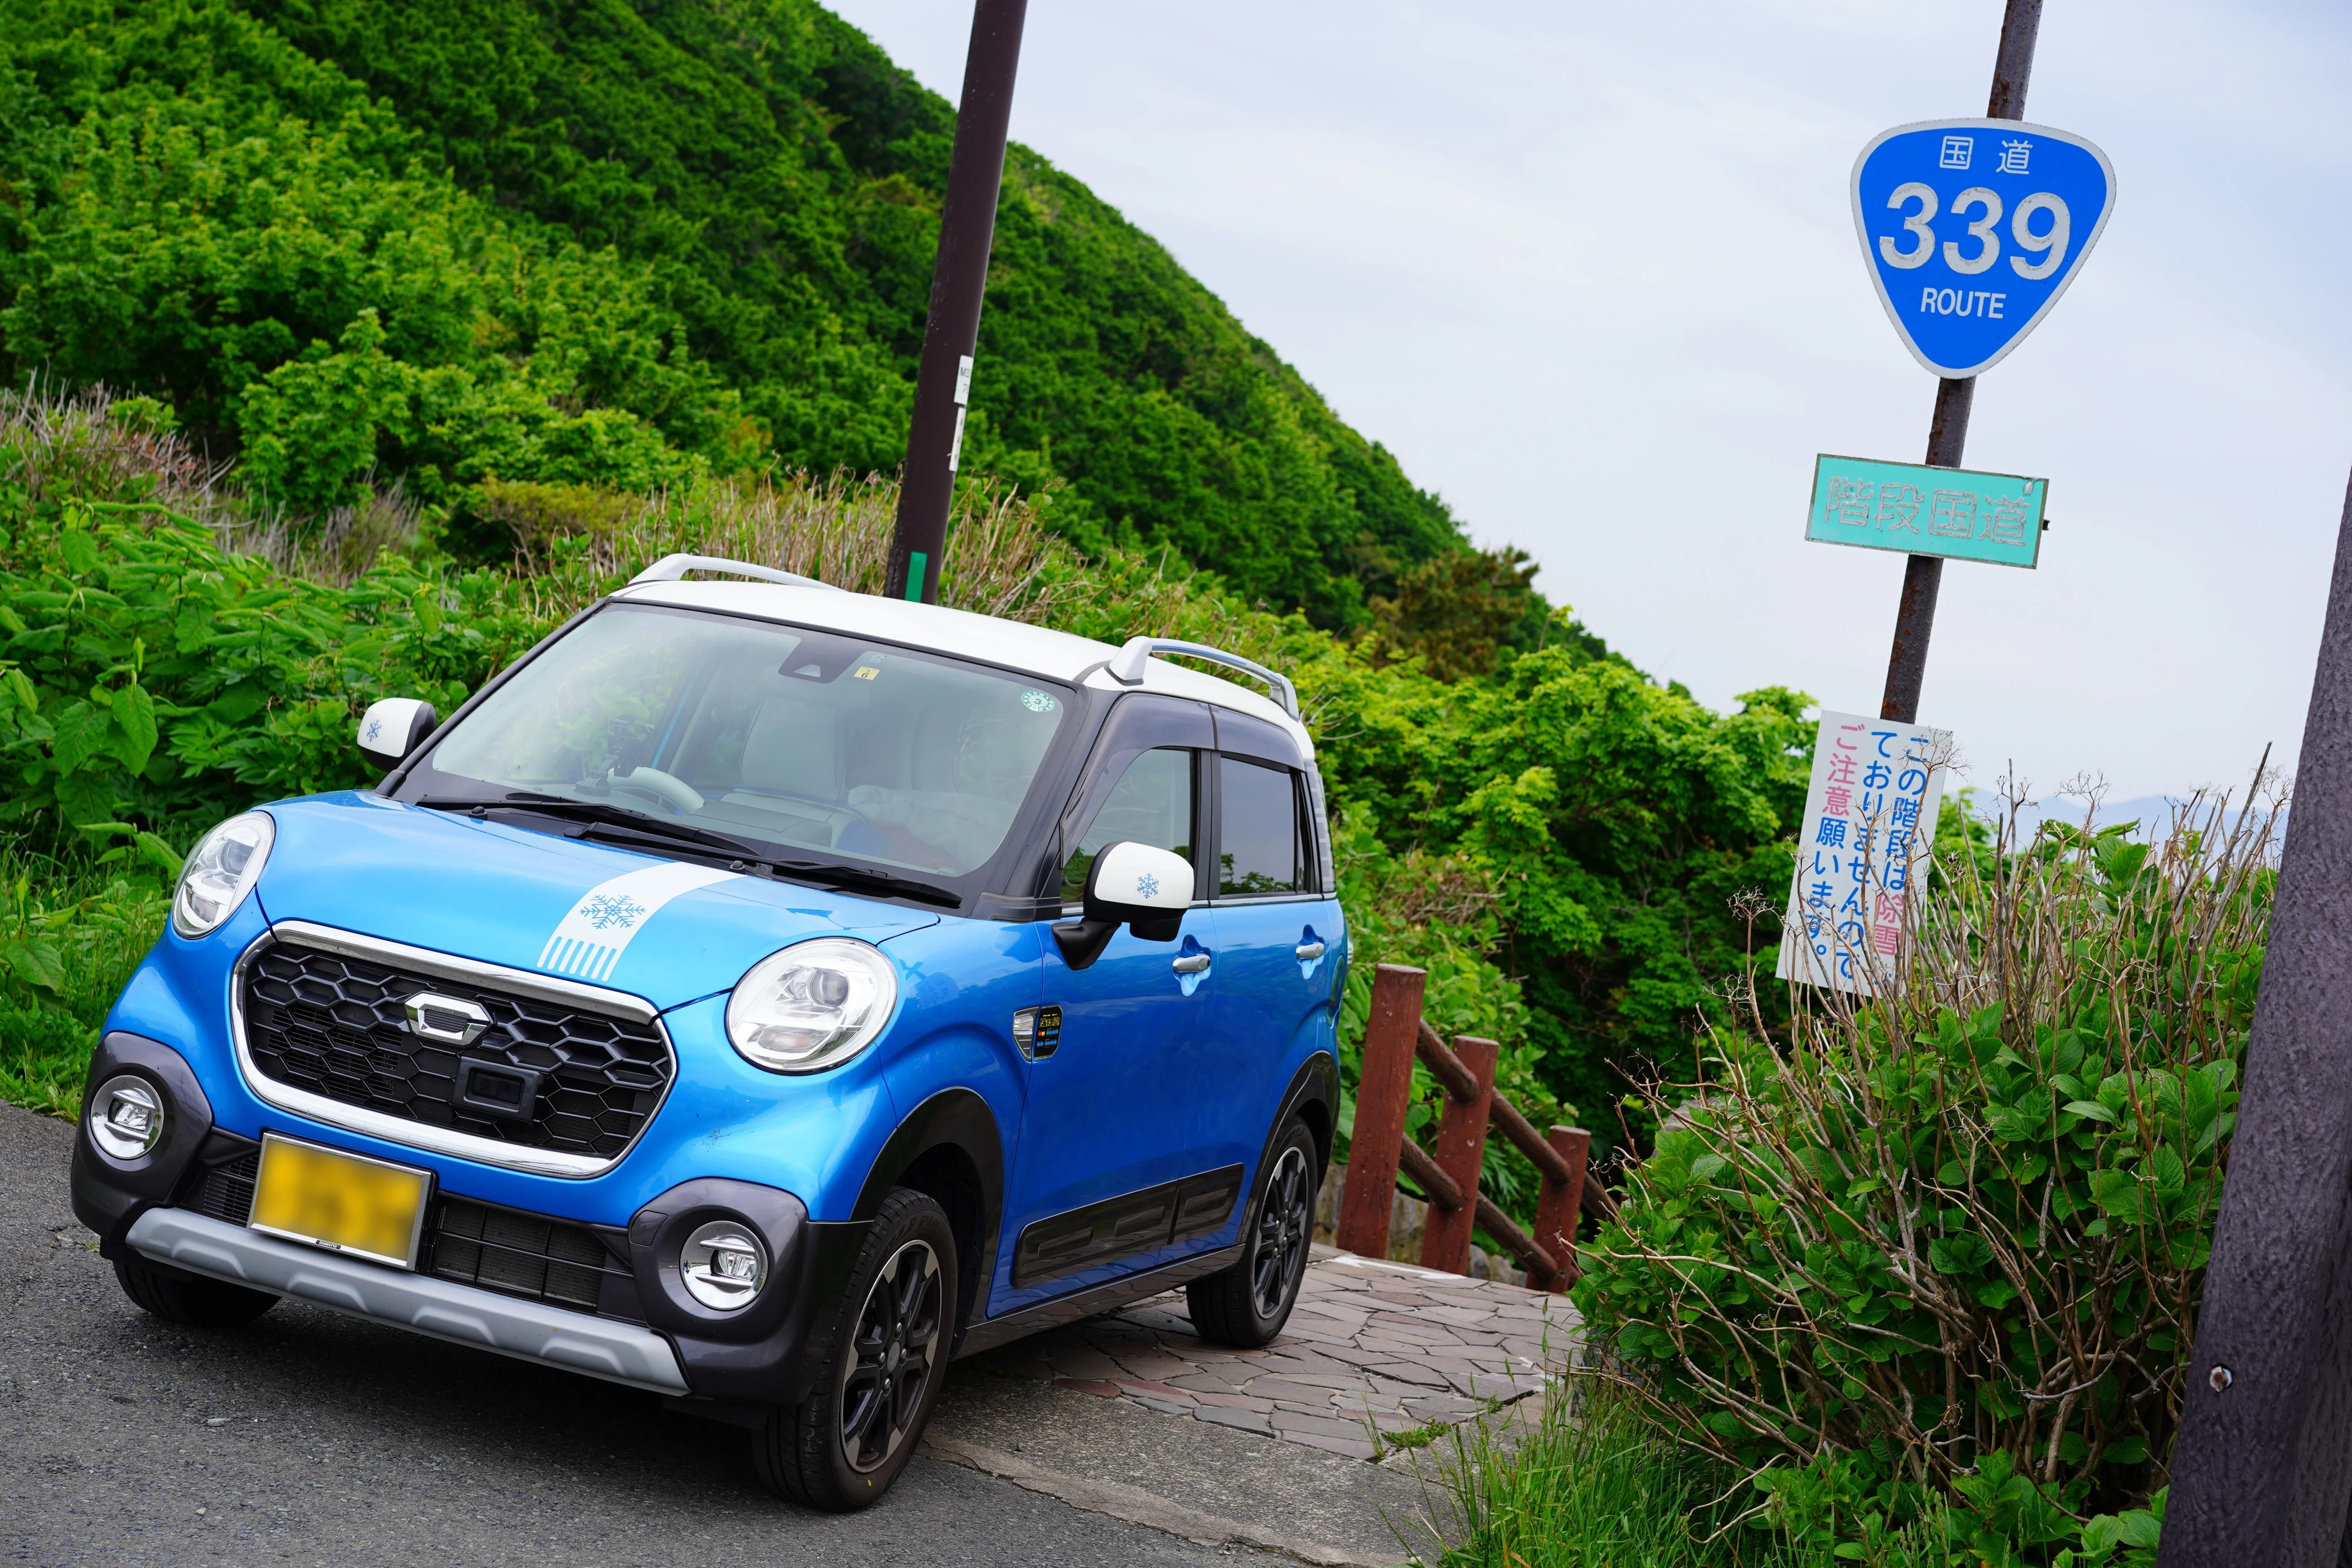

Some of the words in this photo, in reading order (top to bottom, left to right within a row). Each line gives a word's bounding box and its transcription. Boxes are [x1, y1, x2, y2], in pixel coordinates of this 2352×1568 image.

[1939, 136, 2033, 175] 国道
[1879, 182, 2071, 280] 339
[1920, 287, 2006, 319] ROUTE
[1824, 476, 2031, 546] 階段国道
[1805, 723, 1865, 956] ご注意願います。
